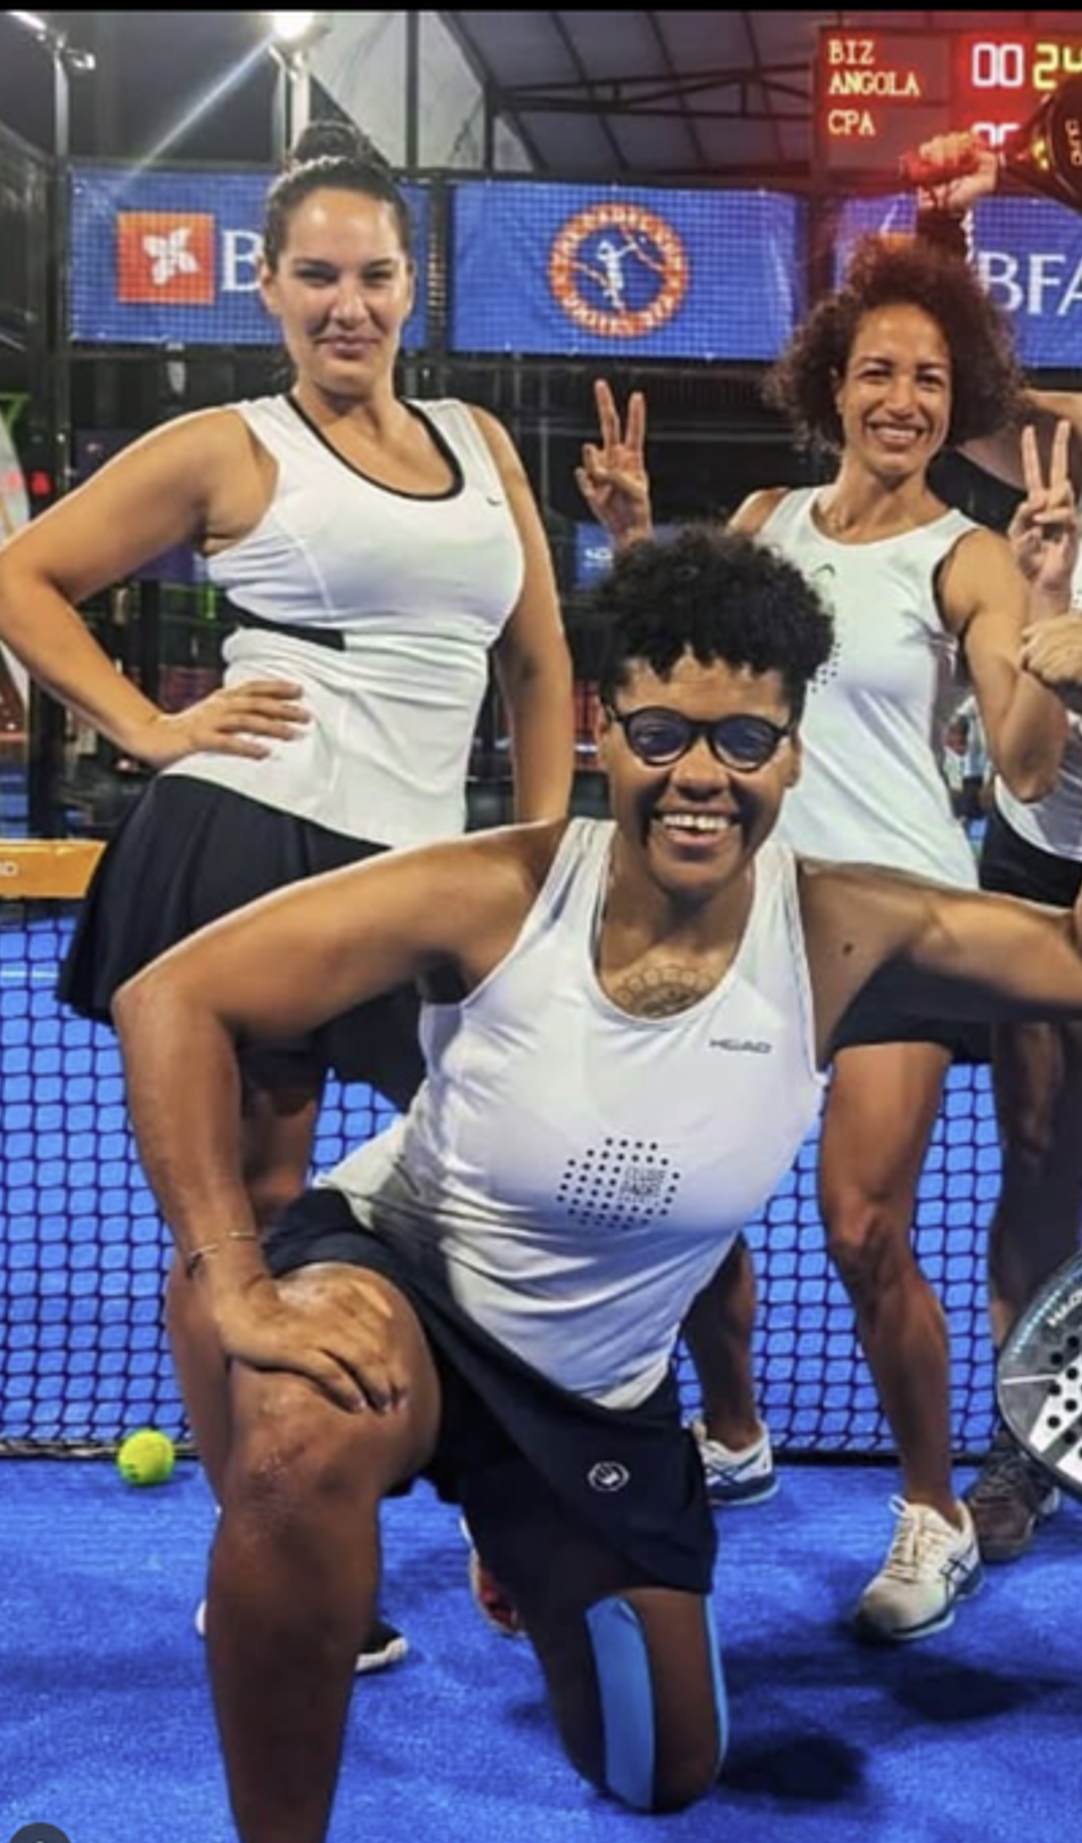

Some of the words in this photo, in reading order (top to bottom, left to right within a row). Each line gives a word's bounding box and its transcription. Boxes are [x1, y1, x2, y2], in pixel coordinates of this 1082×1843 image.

[828, 39, 875, 65] BIZ
[972, 43, 1024, 88] 00
[828, 70, 921, 96] ANGOLA
[828, 108, 876, 136] CPA
